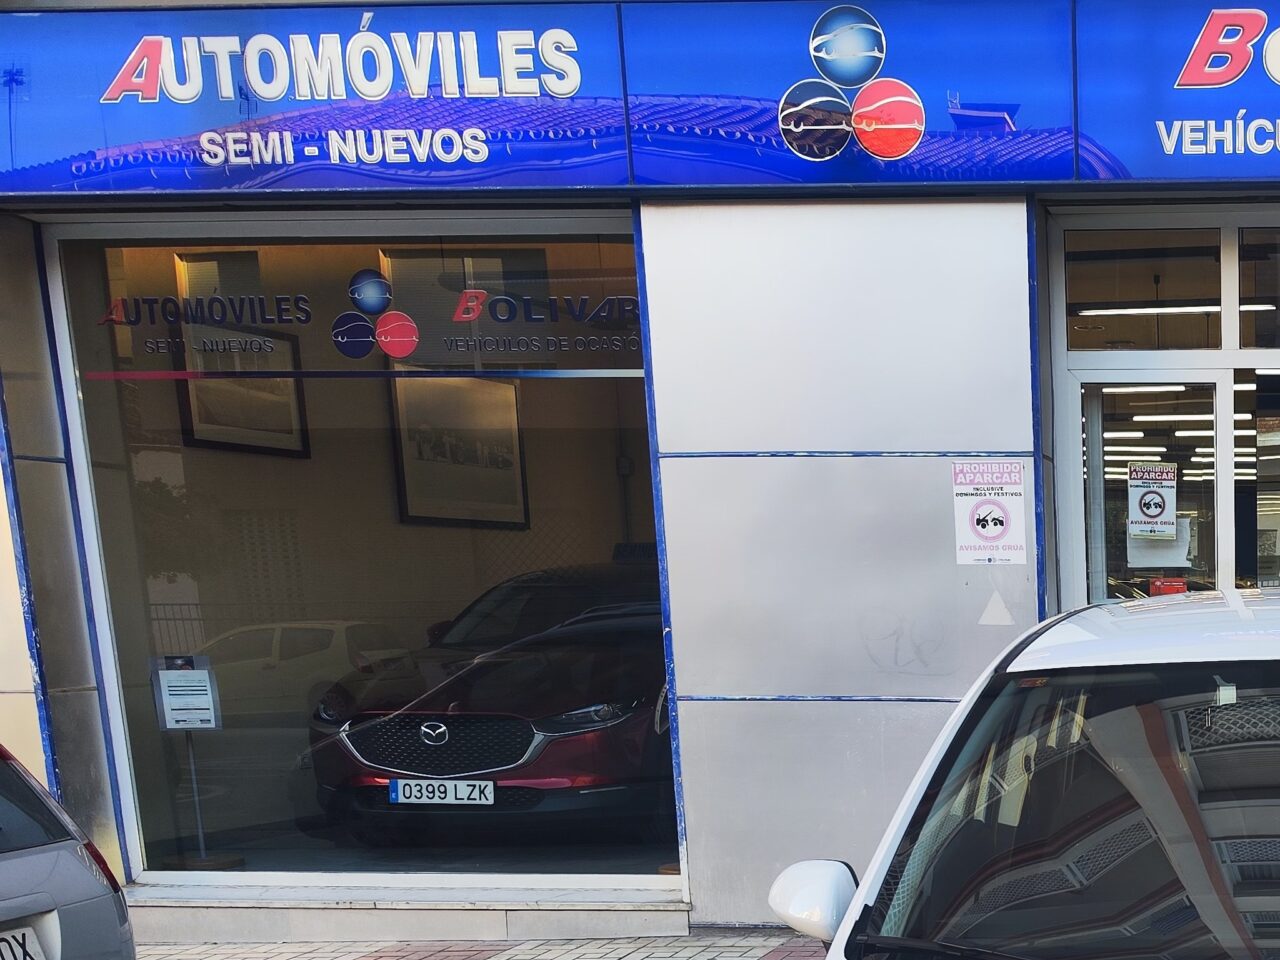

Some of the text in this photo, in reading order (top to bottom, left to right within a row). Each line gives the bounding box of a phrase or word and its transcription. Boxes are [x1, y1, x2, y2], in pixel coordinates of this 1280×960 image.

[101, 13, 581, 103] AUTOMÓVILES
[200, 131, 294, 166] SEMI
[329, 127, 489, 164] NUEVOS
[97, 286, 312, 326] AUTOMÓVILES
[202, 337, 274, 354] NUEVOS
[444, 331, 541, 352] VEHÍCULOS
[547, 336, 570, 351] DE
[955, 463, 1020, 474] PROHIBIDO
[1130, 472, 1175, 480] APARCAR
[956, 472, 1021, 484] APARCAR
[959, 544, 1000, 552] AVISAMOS
[402, 783, 447, 800] 0399
[454, 783, 489, 801] LZK
